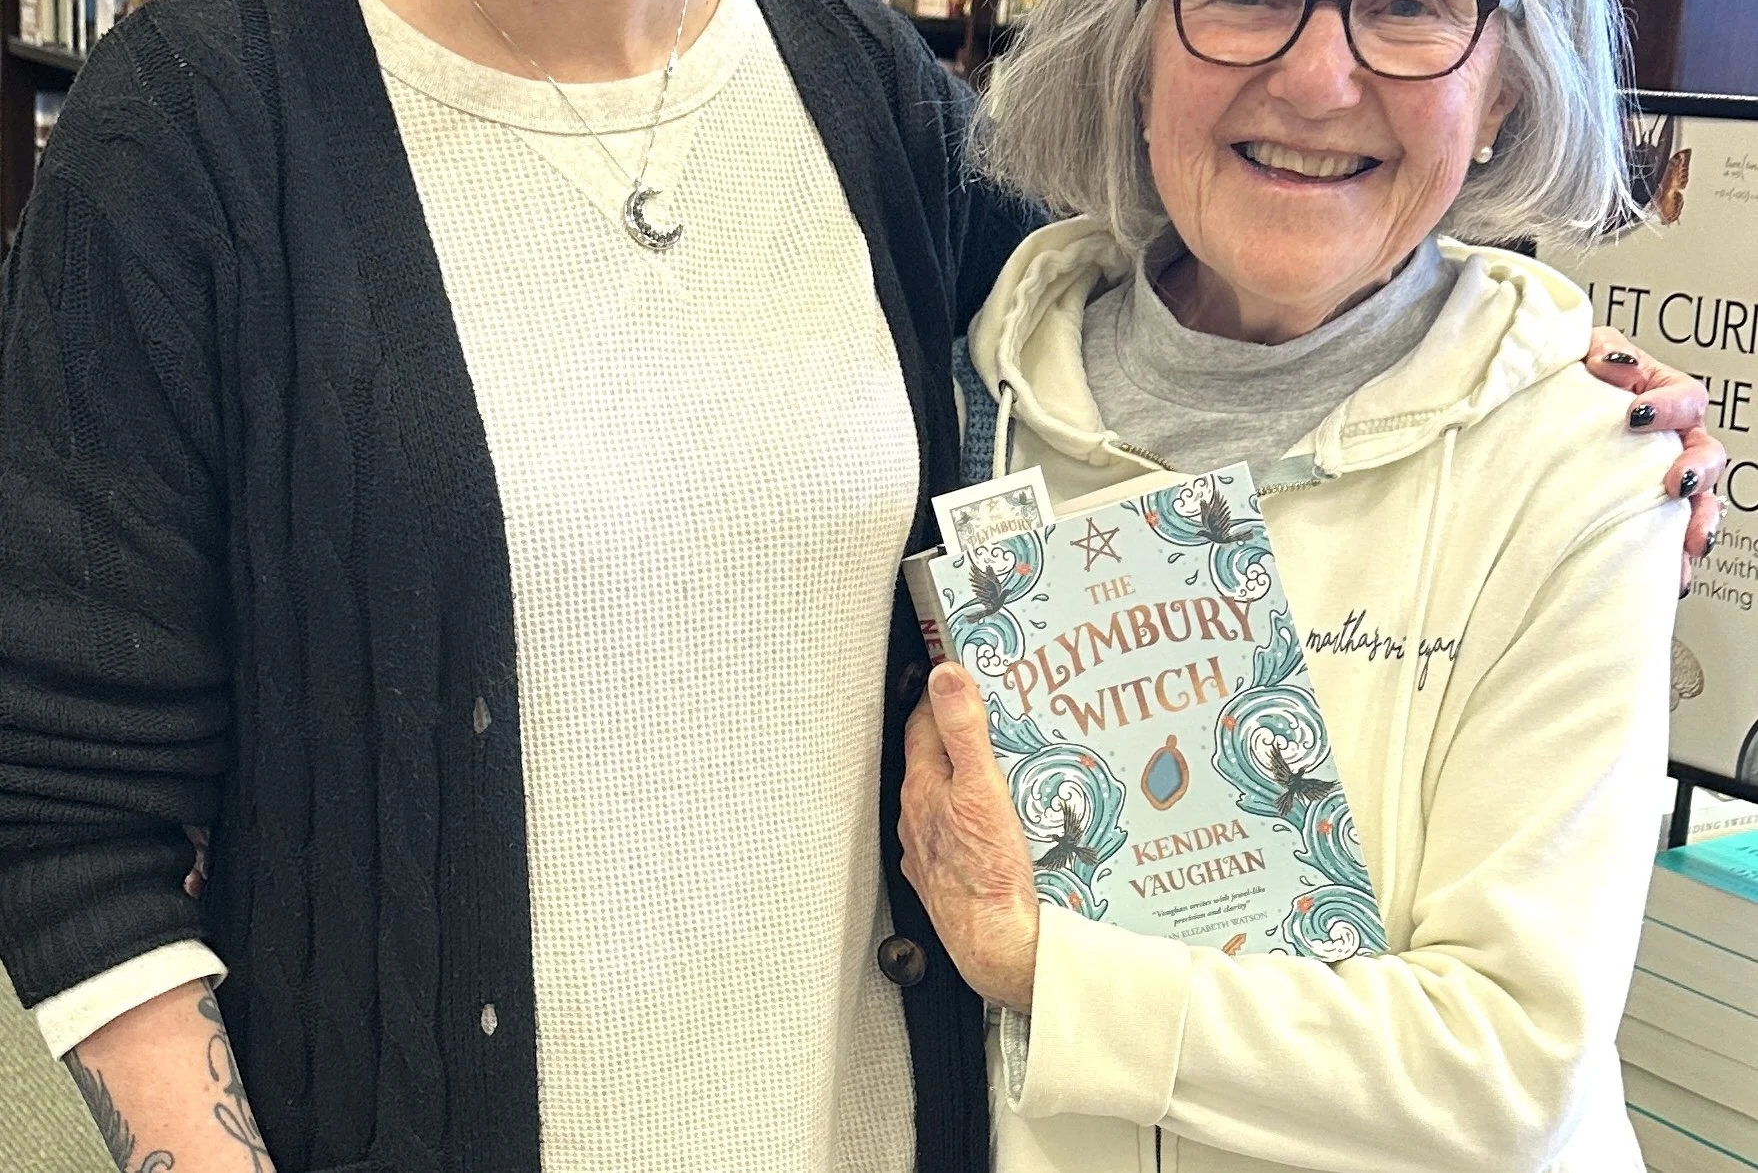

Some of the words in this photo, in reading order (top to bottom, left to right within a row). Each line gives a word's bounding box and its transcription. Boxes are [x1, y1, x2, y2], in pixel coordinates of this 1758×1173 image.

[1686, 372, 1753, 433] HE
[967, 518, 1033, 550] PLYMBURY
[1084, 574, 1137, 605] THE
[1692, 575, 1754, 611] inking
[1002, 595, 1256, 715] PLYMBURY
[1050, 655, 1230, 737] WITCH
[1130, 818, 1250, 867] KENDRA
[1128, 847, 1267, 899] VAUGHAN
[1180, 920, 1230, 939] ELIZABETH
[1230, 911, 1268, 926] WATSON
[1206, 906, 1222, 917] and
